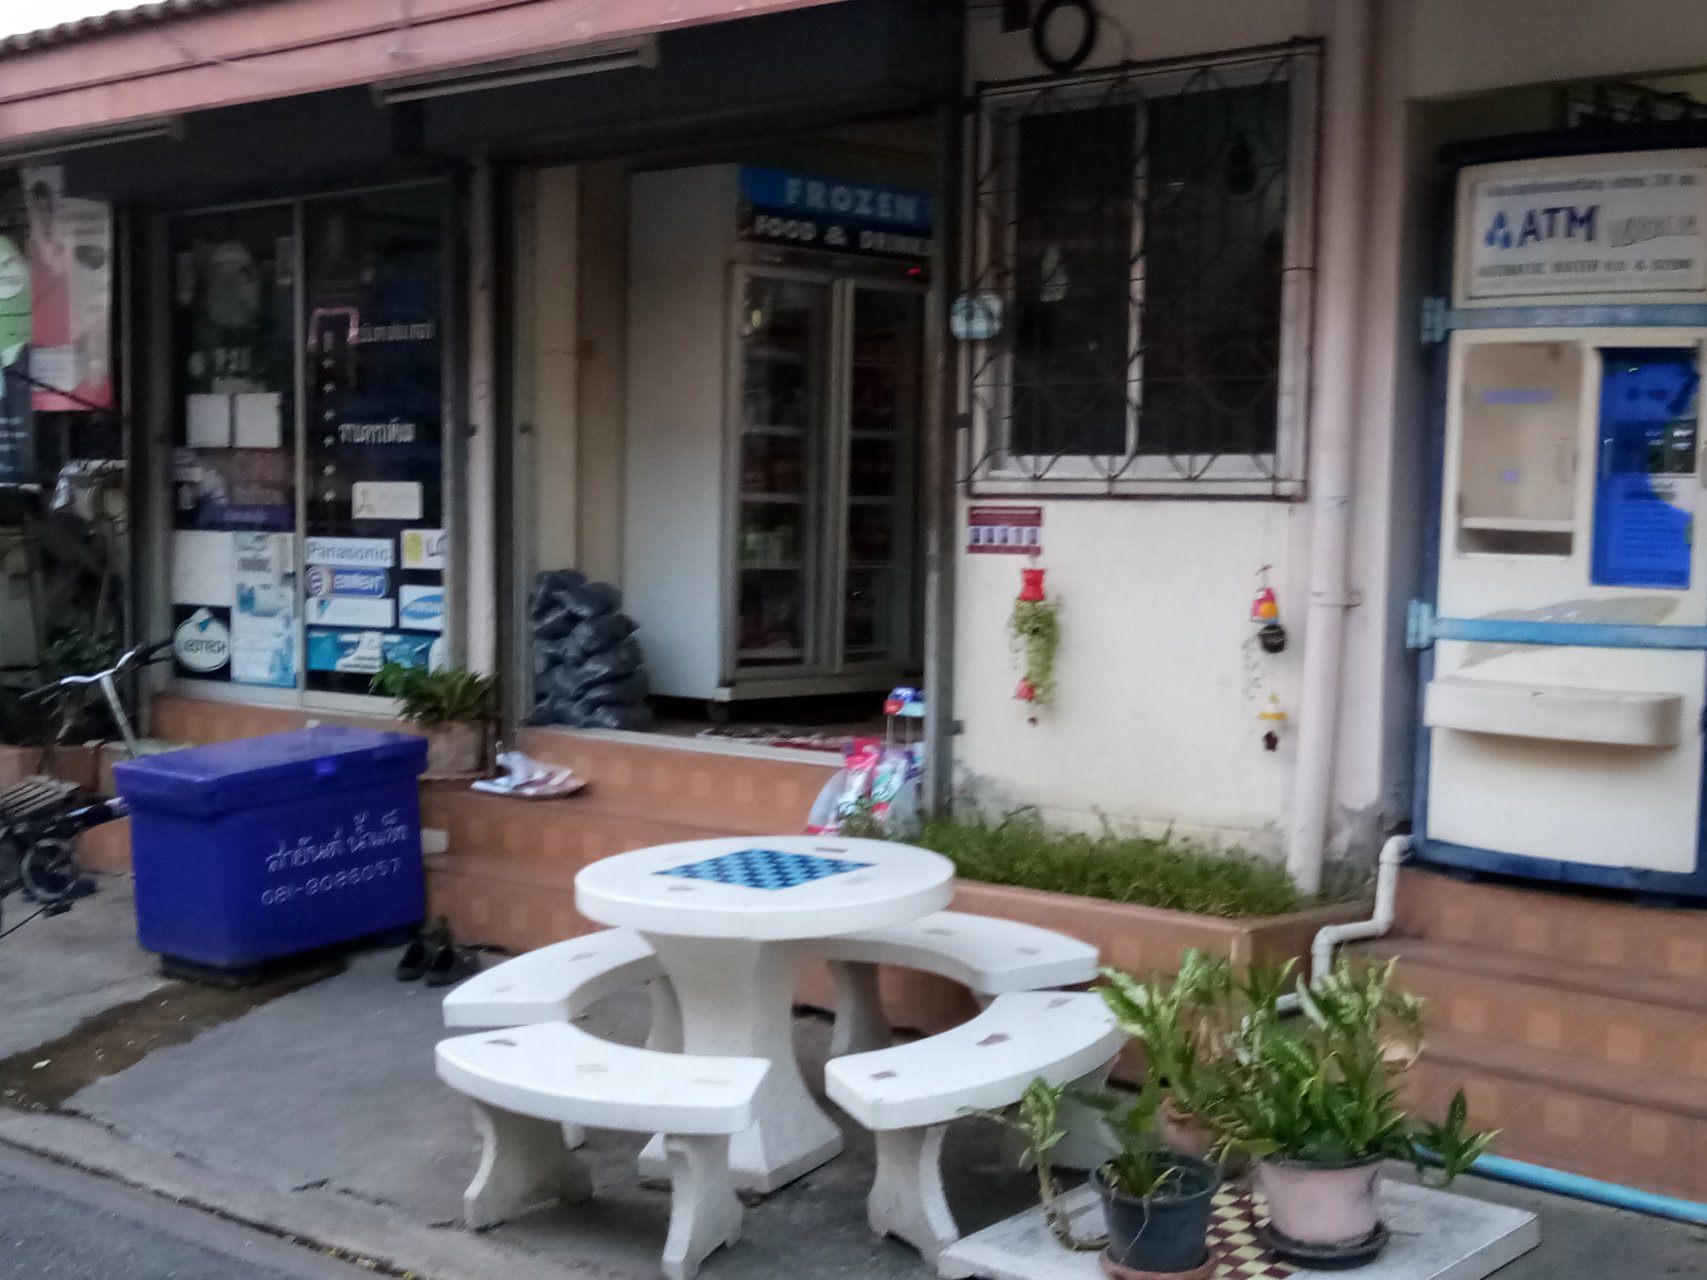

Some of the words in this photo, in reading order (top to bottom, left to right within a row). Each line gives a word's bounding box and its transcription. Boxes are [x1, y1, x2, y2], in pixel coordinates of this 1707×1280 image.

[785, 178, 917, 222] FROZEN
[1516, 205, 1599, 247] ATM
[306, 541, 391, 561] Panasonic
